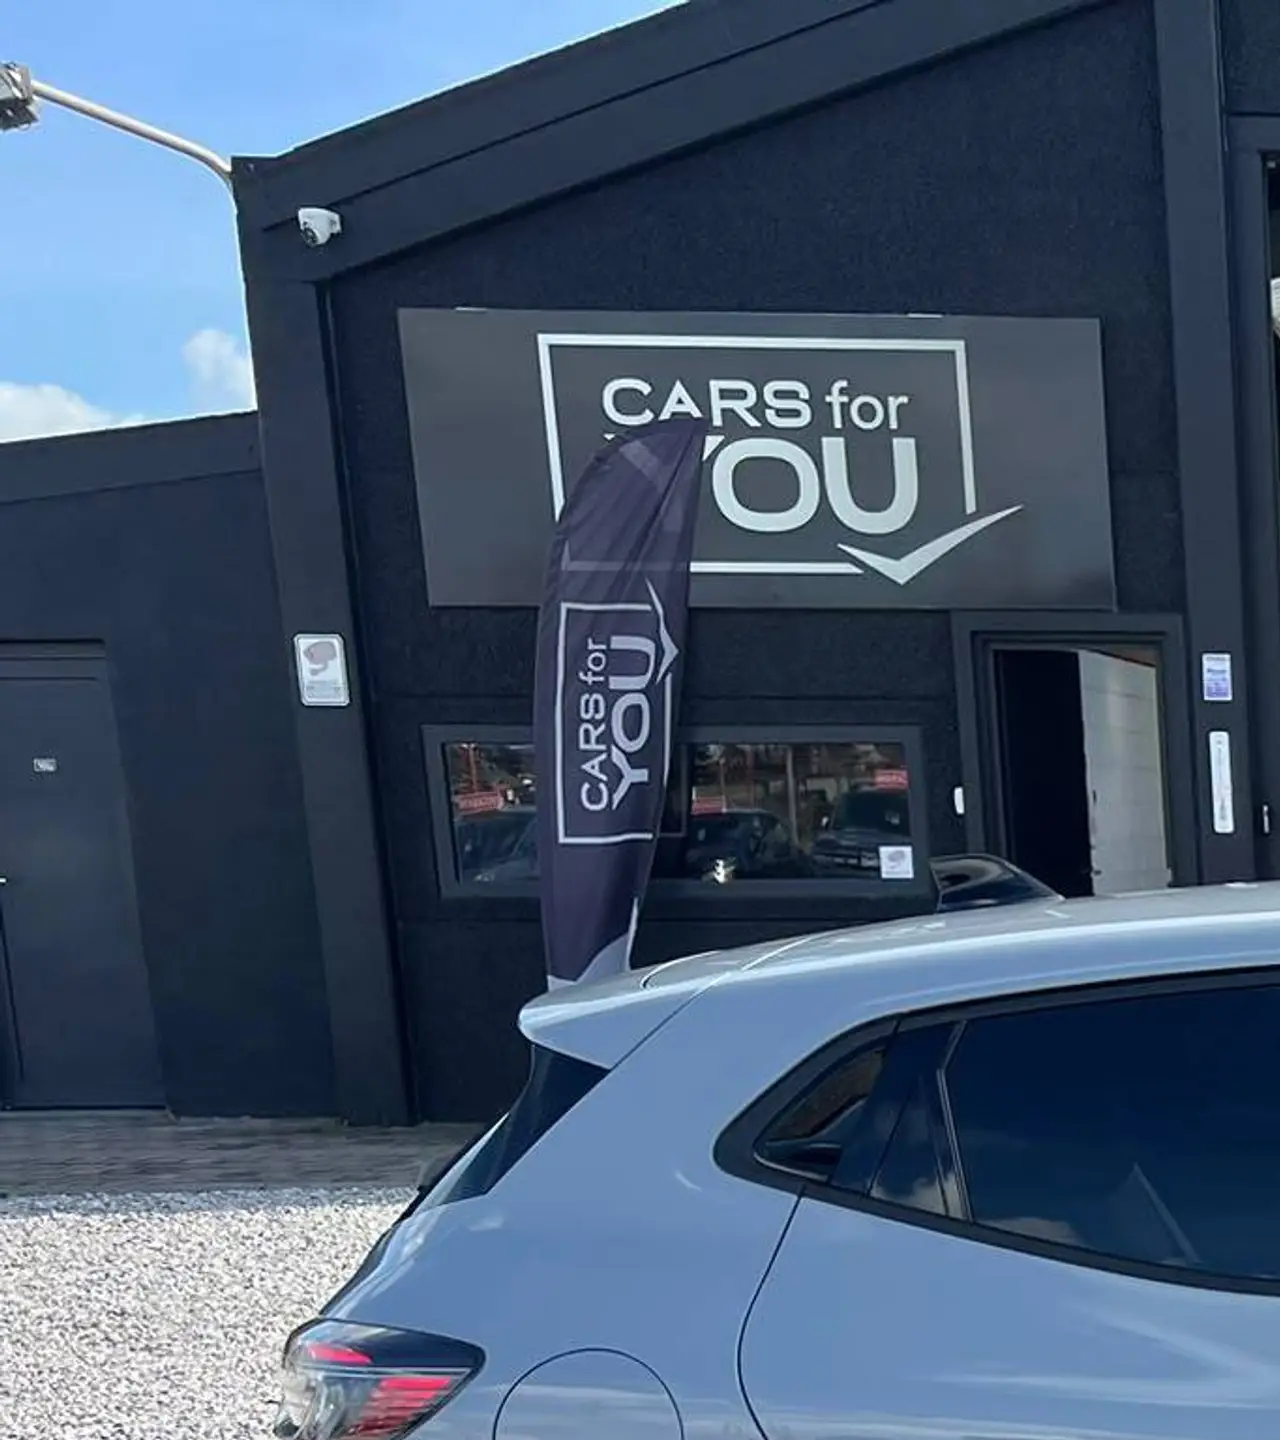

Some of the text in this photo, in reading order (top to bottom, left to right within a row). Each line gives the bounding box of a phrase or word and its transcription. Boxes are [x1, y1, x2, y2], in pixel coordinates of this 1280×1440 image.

[602, 378, 909, 430] CARS for
[603, 434, 919, 534] OU
[579, 637, 609, 812] CARS for
[610, 634, 656, 811] YOU
